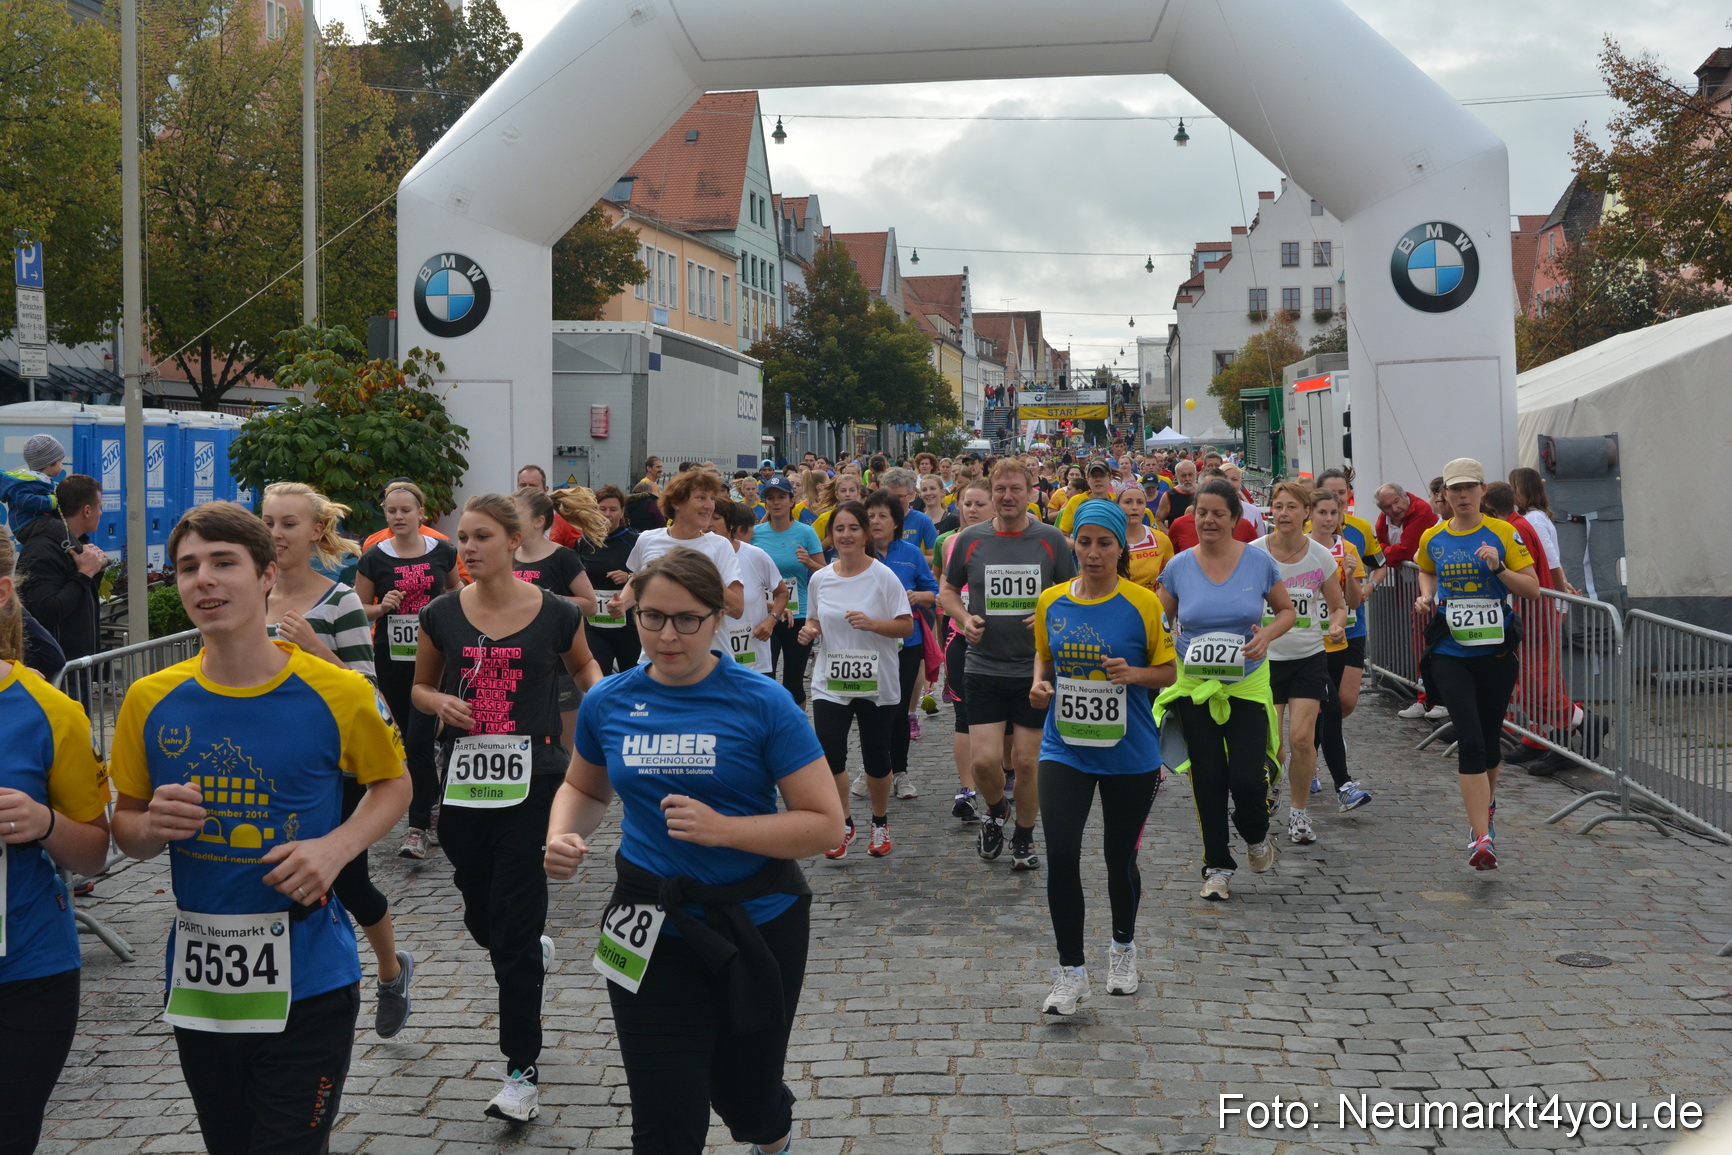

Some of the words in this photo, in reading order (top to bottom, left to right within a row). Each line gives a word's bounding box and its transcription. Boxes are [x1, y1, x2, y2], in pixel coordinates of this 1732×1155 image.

[1397, 223, 1473, 255] BMW
[419, 254, 485, 283] BMW
[1047, 408, 1078, 417] START
[1136, 551, 1160, 560] BÖGL
[991, 577, 1037, 596] 5019
[990, 600, 1036, 609] Hans-Jürgen
[1452, 609, 1498, 628] 5210
[1207, 636, 1235, 644] Neumarkt
[463, 647, 487, 657] WIR
[491, 647, 521, 658] SIND
[1191, 644, 1239, 664] 5027
[502, 668, 522, 679] DIE
[830, 661, 873, 679] 5033
[1202, 667, 1226, 676] Sylvia
[842, 682, 860, 690] Anita
[1057, 683, 1078, 692] PARTL
[1078, 686, 1113, 694] Neumarkt
[476, 689, 506, 700] ABER
[1061, 694, 1119, 721] 5538
[486, 720, 515, 732] AUCH
[455, 743, 477, 751] PARTL
[622, 734, 717, 755] HUBER
[640, 756, 711, 765] TECHNOLOGY
[456, 753, 523, 781] 5096
[470, 786, 504, 798] Selina
[178, 920, 207, 935] PARTL
[208, 926, 265, 938] Neumarkt
[185, 939, 279, 988] 5534
